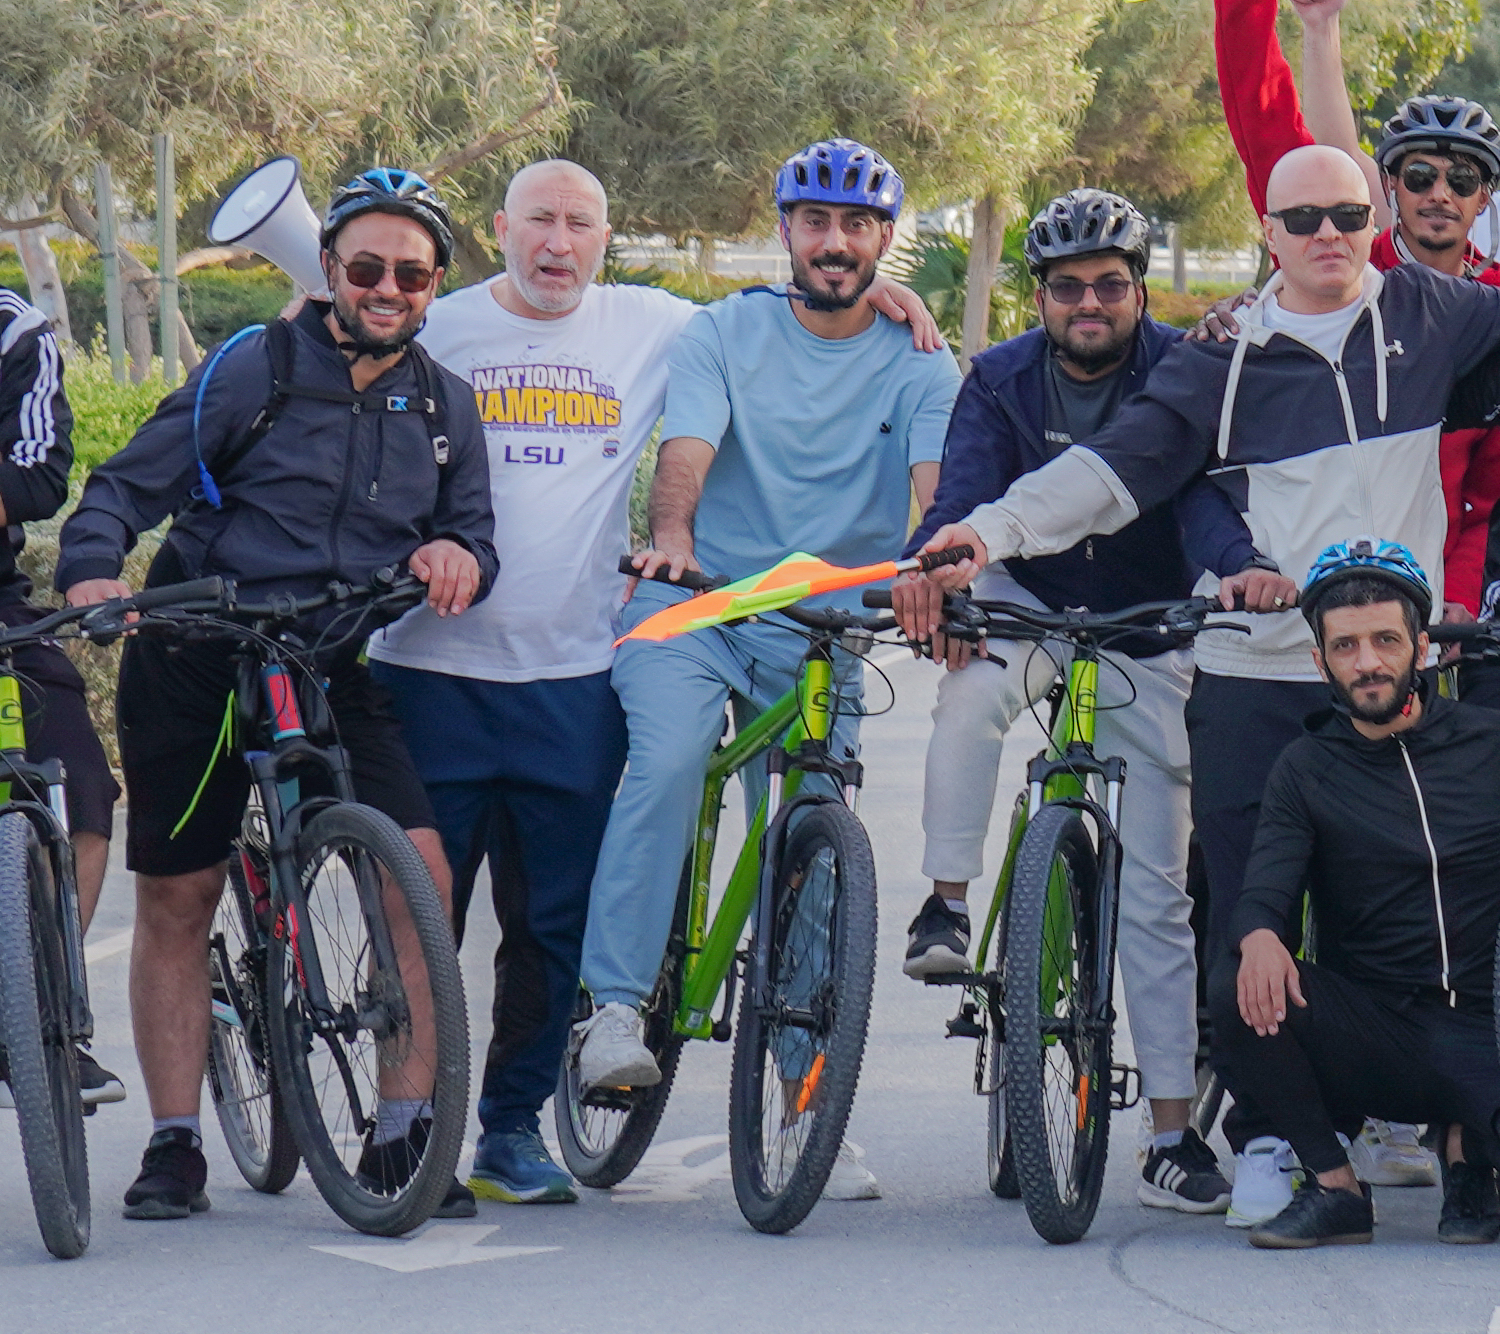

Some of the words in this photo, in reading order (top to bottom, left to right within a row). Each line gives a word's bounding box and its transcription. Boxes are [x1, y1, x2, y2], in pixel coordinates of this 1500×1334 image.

[472, 364, 598, 395] NATIONAL
[475, 387, 621, 427] AMPIONS
[505, 445, 565, 465] LSU
